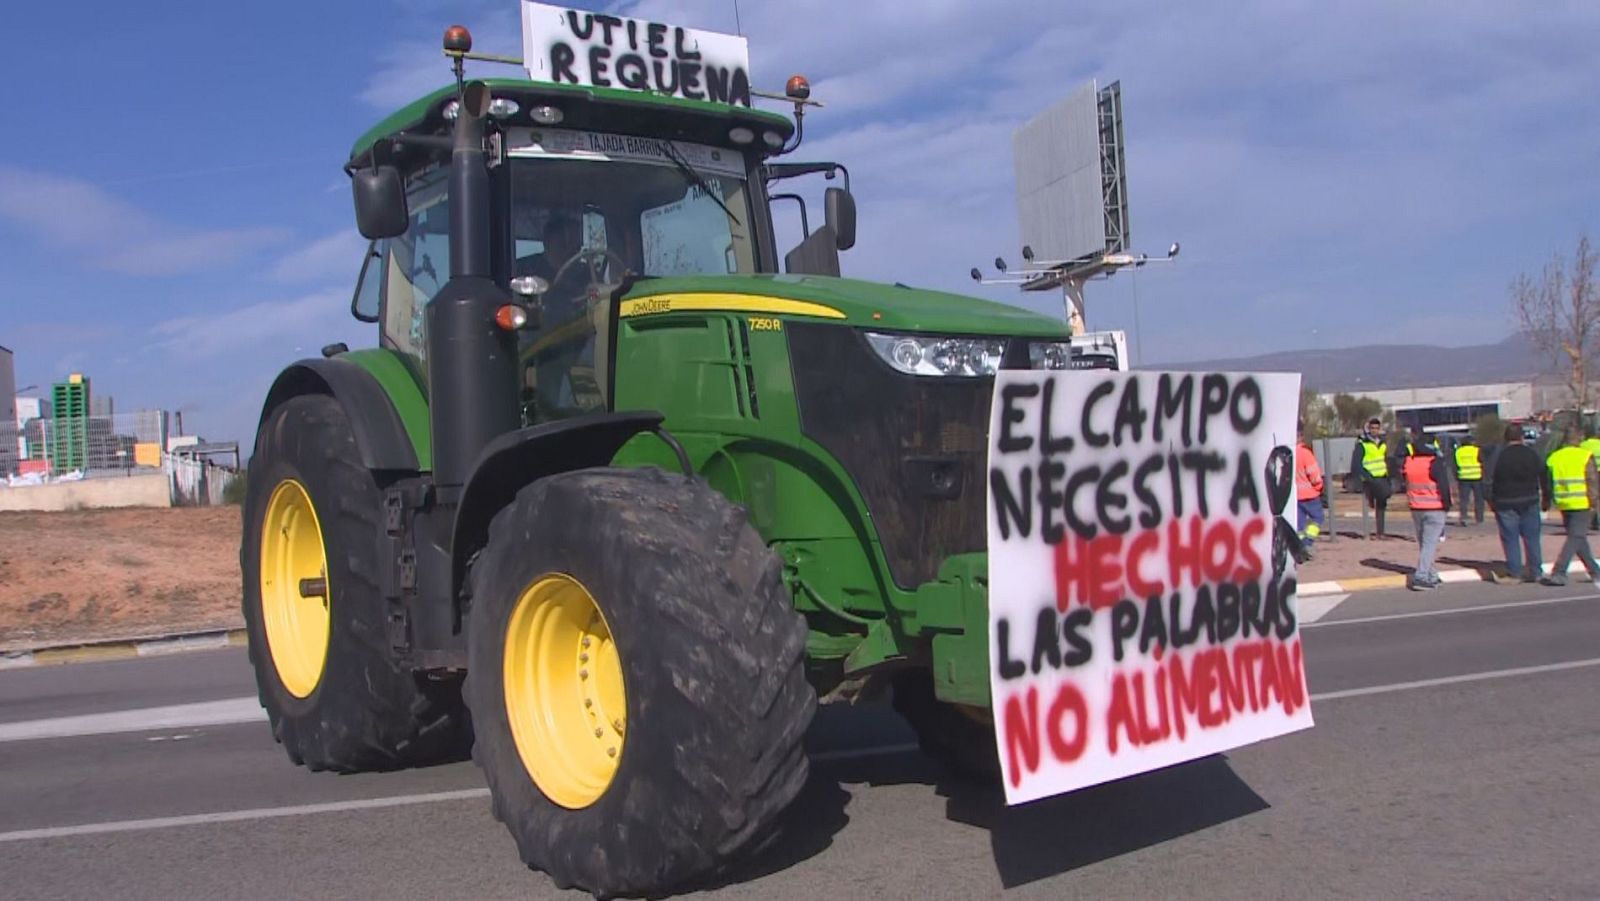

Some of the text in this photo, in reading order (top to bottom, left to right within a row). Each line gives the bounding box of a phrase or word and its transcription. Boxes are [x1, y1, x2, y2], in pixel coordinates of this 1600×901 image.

[551, 42, 750, 107] REQUENA
[567, 10, 701, 60] UTIEL
[588, 133, 625, 153] TAJADA
[632, 298, 671, 313] JOHN DEERE
[998, 373, 1263, 455] EL CAMPO
[990, 450, 1260, 544] NECESITA
[1054, 514, 1265, 613] HECHOS
[997, 577, 1298, 679] LAS PALABRAS
[1004, 679, 1089, 788] NO
